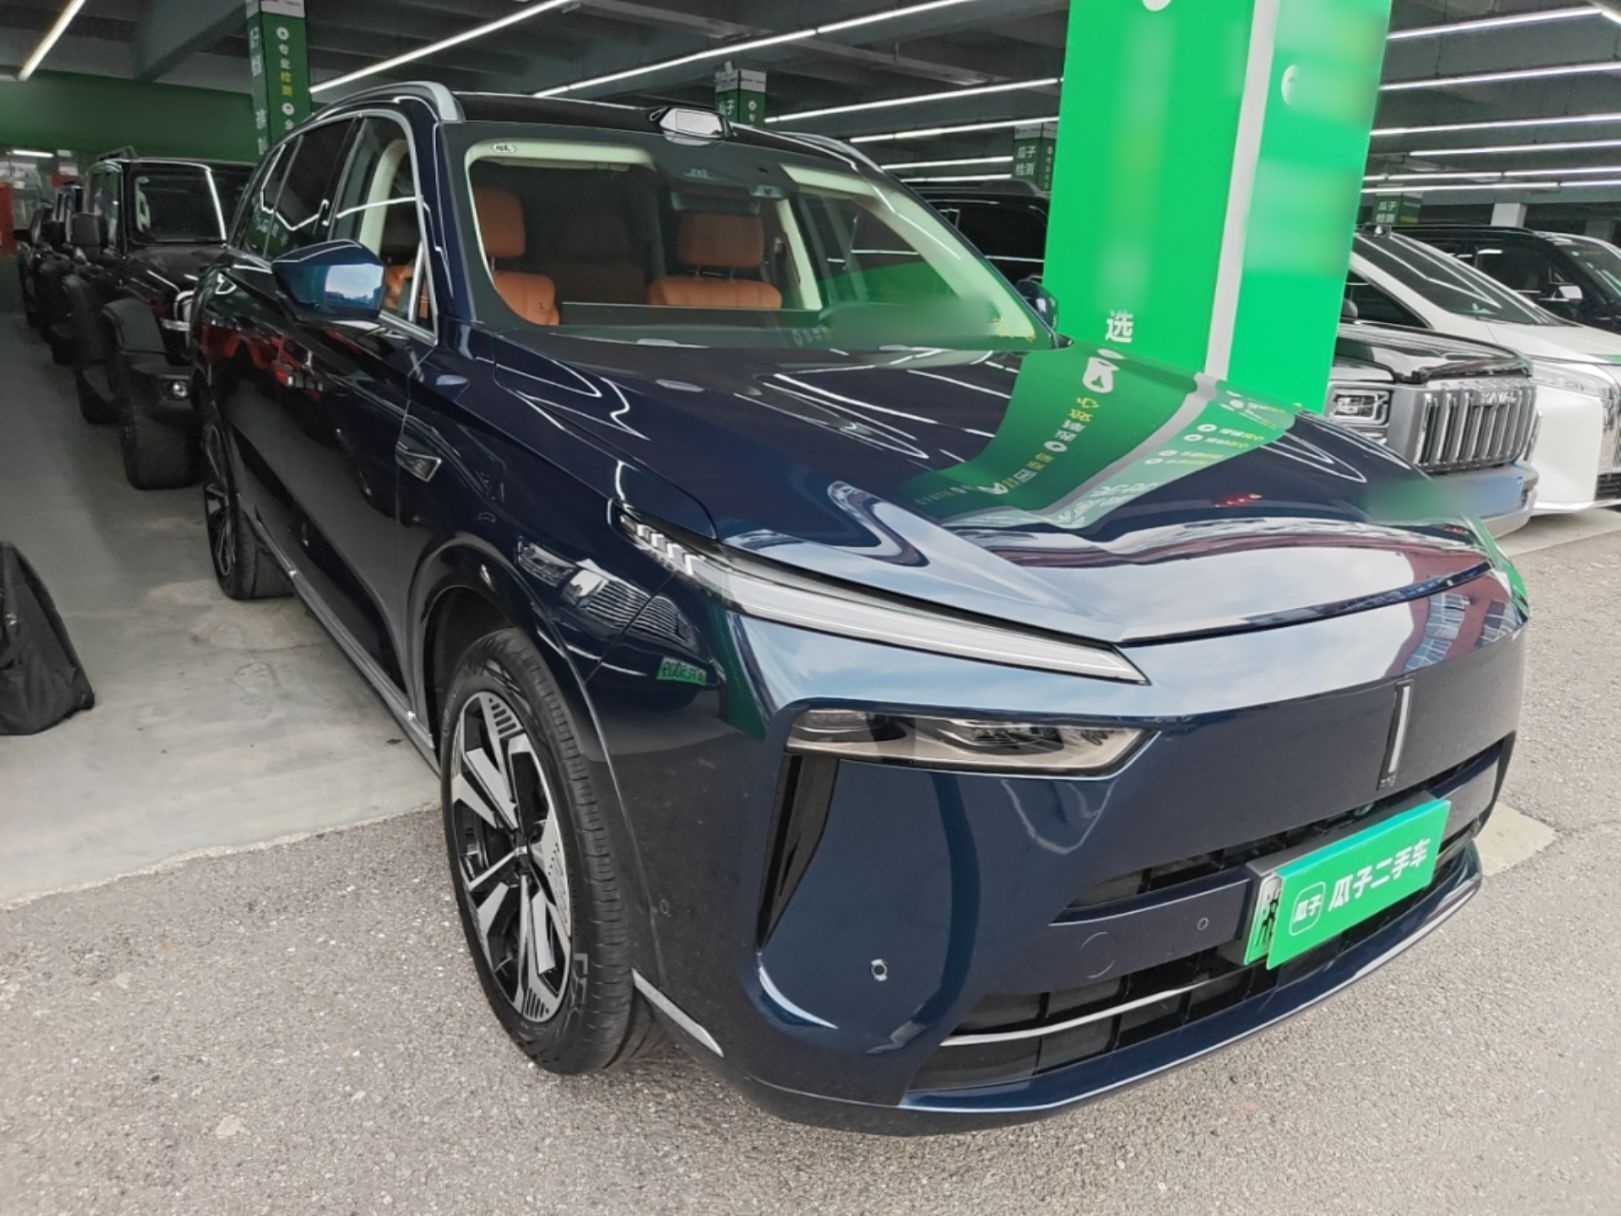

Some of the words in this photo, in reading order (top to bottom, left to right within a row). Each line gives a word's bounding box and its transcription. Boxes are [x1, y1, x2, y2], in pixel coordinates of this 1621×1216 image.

[1105, 310, 1133, 343] 选
[1327, 838, 1431, 912] 瓜子二手车
[1293, 895, 1321, 922] 瓜子
